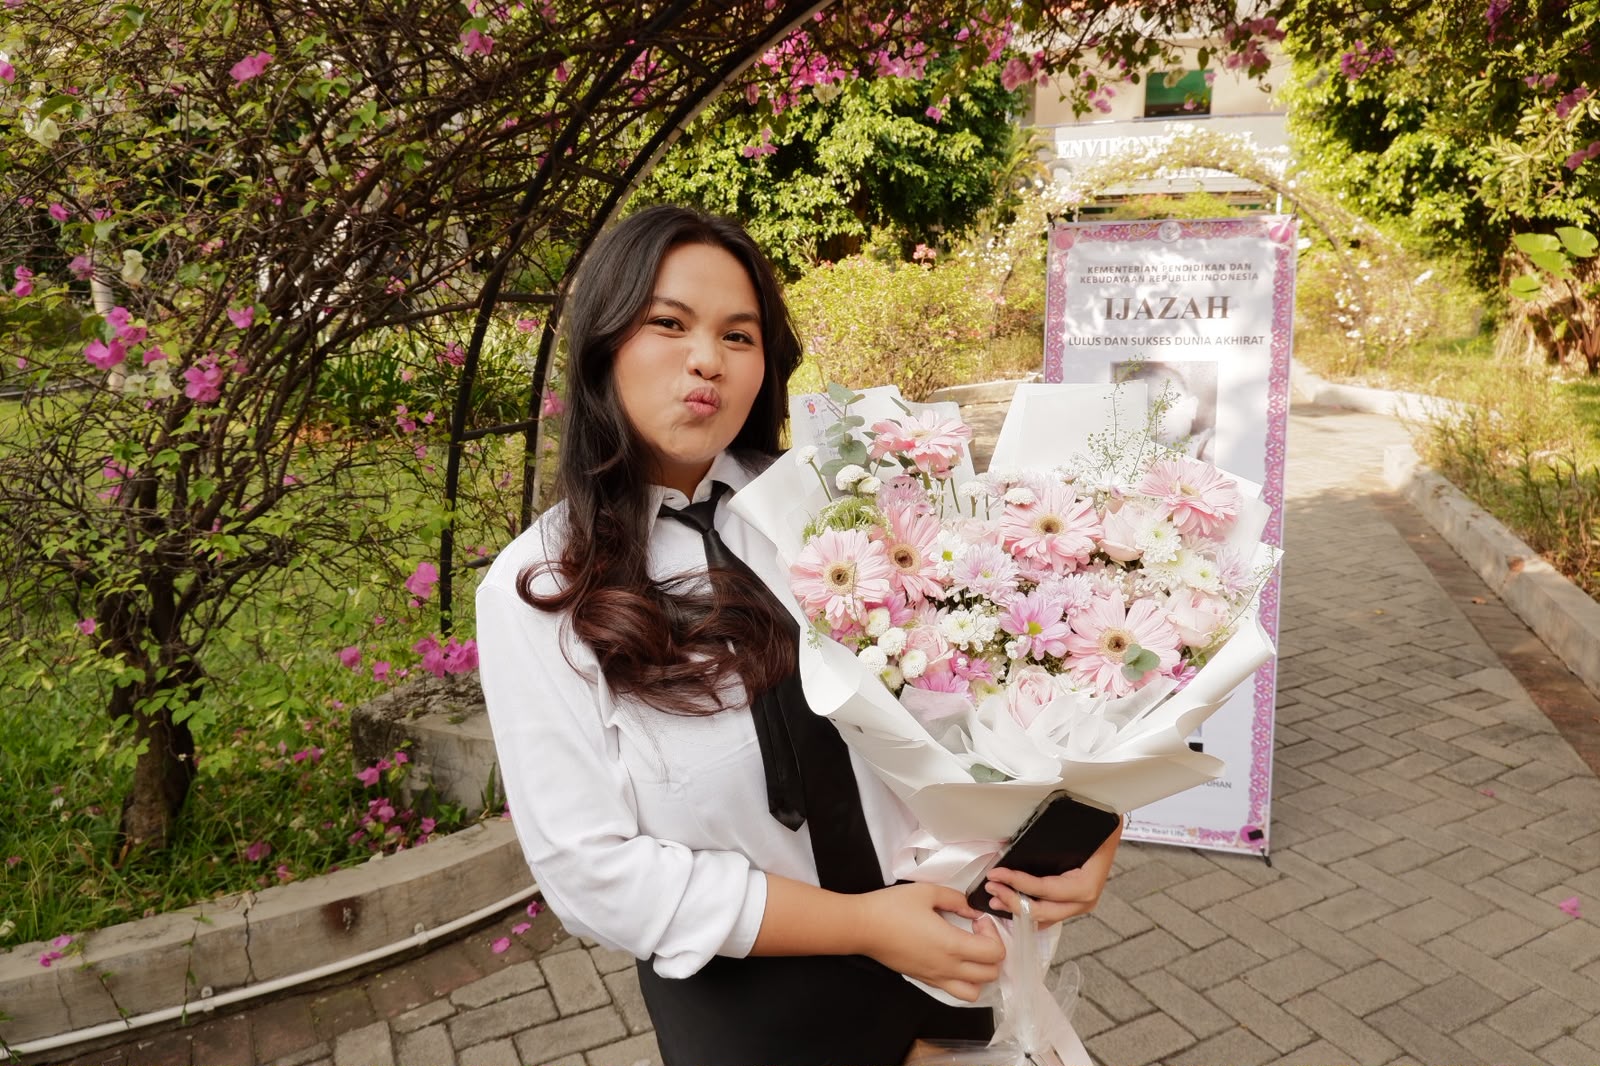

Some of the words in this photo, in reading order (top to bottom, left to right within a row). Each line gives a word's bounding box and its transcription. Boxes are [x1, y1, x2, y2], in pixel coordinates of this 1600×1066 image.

[1087, 265, 1158, 275] KEMENTERIAN
[1162, 264, 1226, 274] PENDIDIKAN
[1229, 262, 1252, 272] DAN
[1080, 275, 1145, 285] KEBUDAYAAN
[1149, 273, 1197, 283] REPUBLIK
[1201, 272, 1259, 282] INDONESIA
[1104, 295, 1231, 320] IJAZAH
[1068, 336, 1101, 346] LULUS
[1104, 336, 1128, 346] DAN
[1130, 336, 1171, 346] SUKSES
[1175, 336, 1212, 346] DUNIA
[1215, 335, 1265, 346] AKHIRAT
